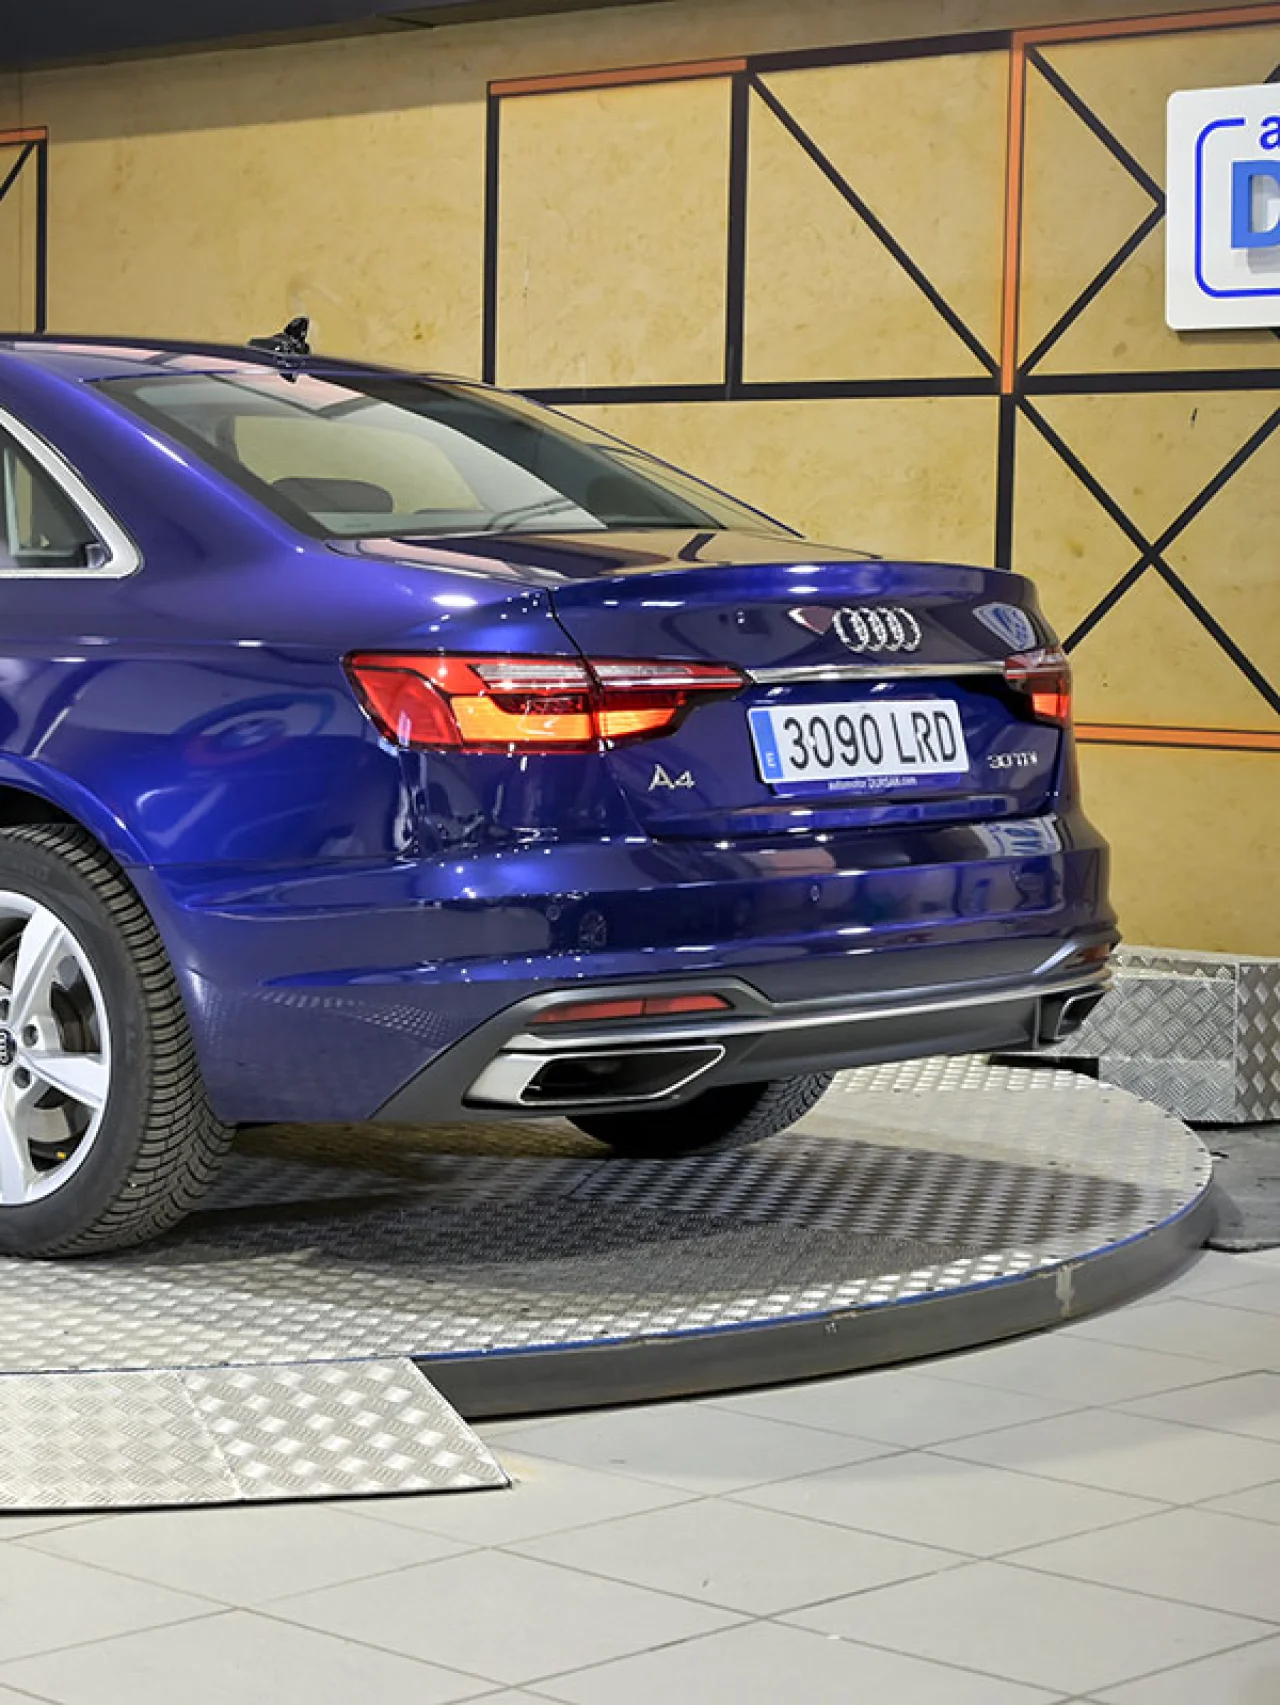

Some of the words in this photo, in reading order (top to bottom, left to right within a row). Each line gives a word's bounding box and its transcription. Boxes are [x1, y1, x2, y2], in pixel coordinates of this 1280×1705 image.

[783, 712, 884, 770] 3090
[889, 710, 957, 765] LRD
[648, 763, 696, 791] A4
